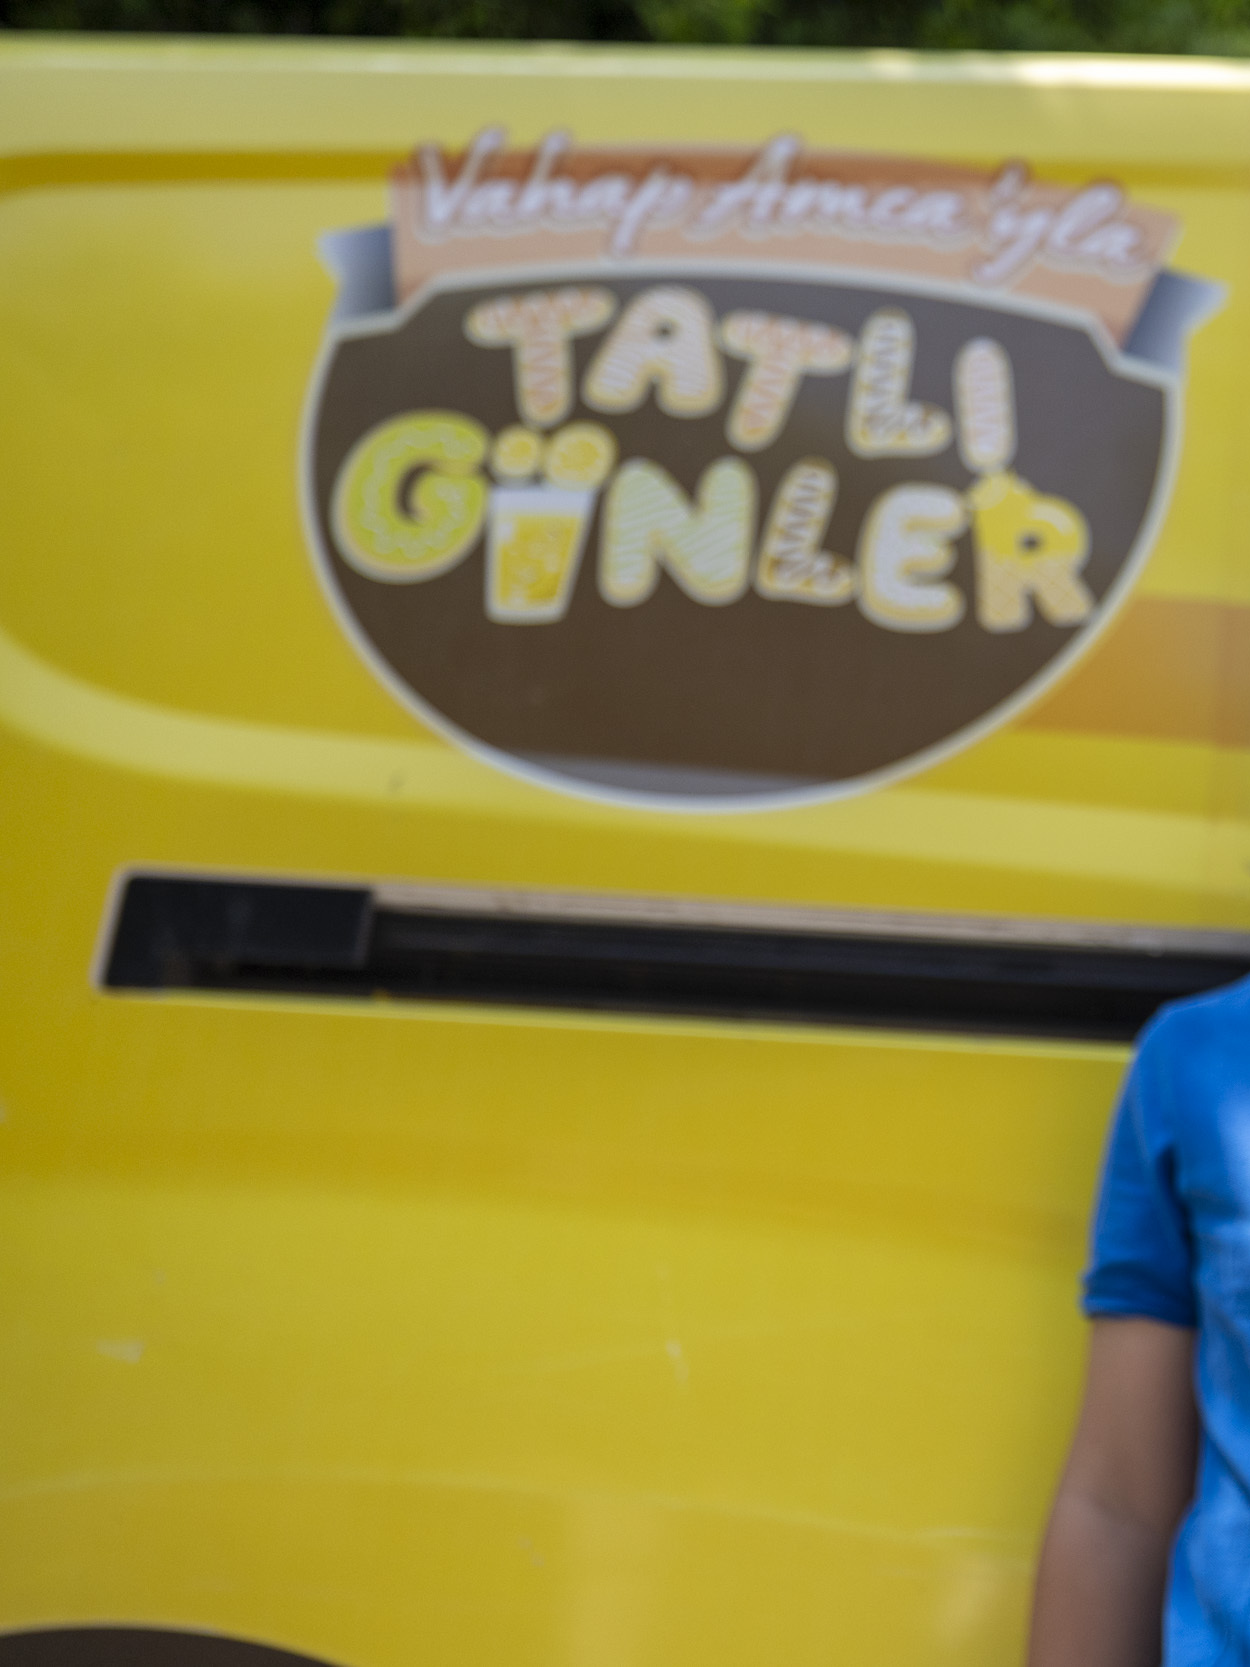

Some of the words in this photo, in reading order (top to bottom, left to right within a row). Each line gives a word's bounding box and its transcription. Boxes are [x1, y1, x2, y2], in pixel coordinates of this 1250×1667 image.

[418, 128, 695, 257] Vahap
[465, 286, 1015, 473] TATLI
[331, 411, 1095, 634] GÜNLER
